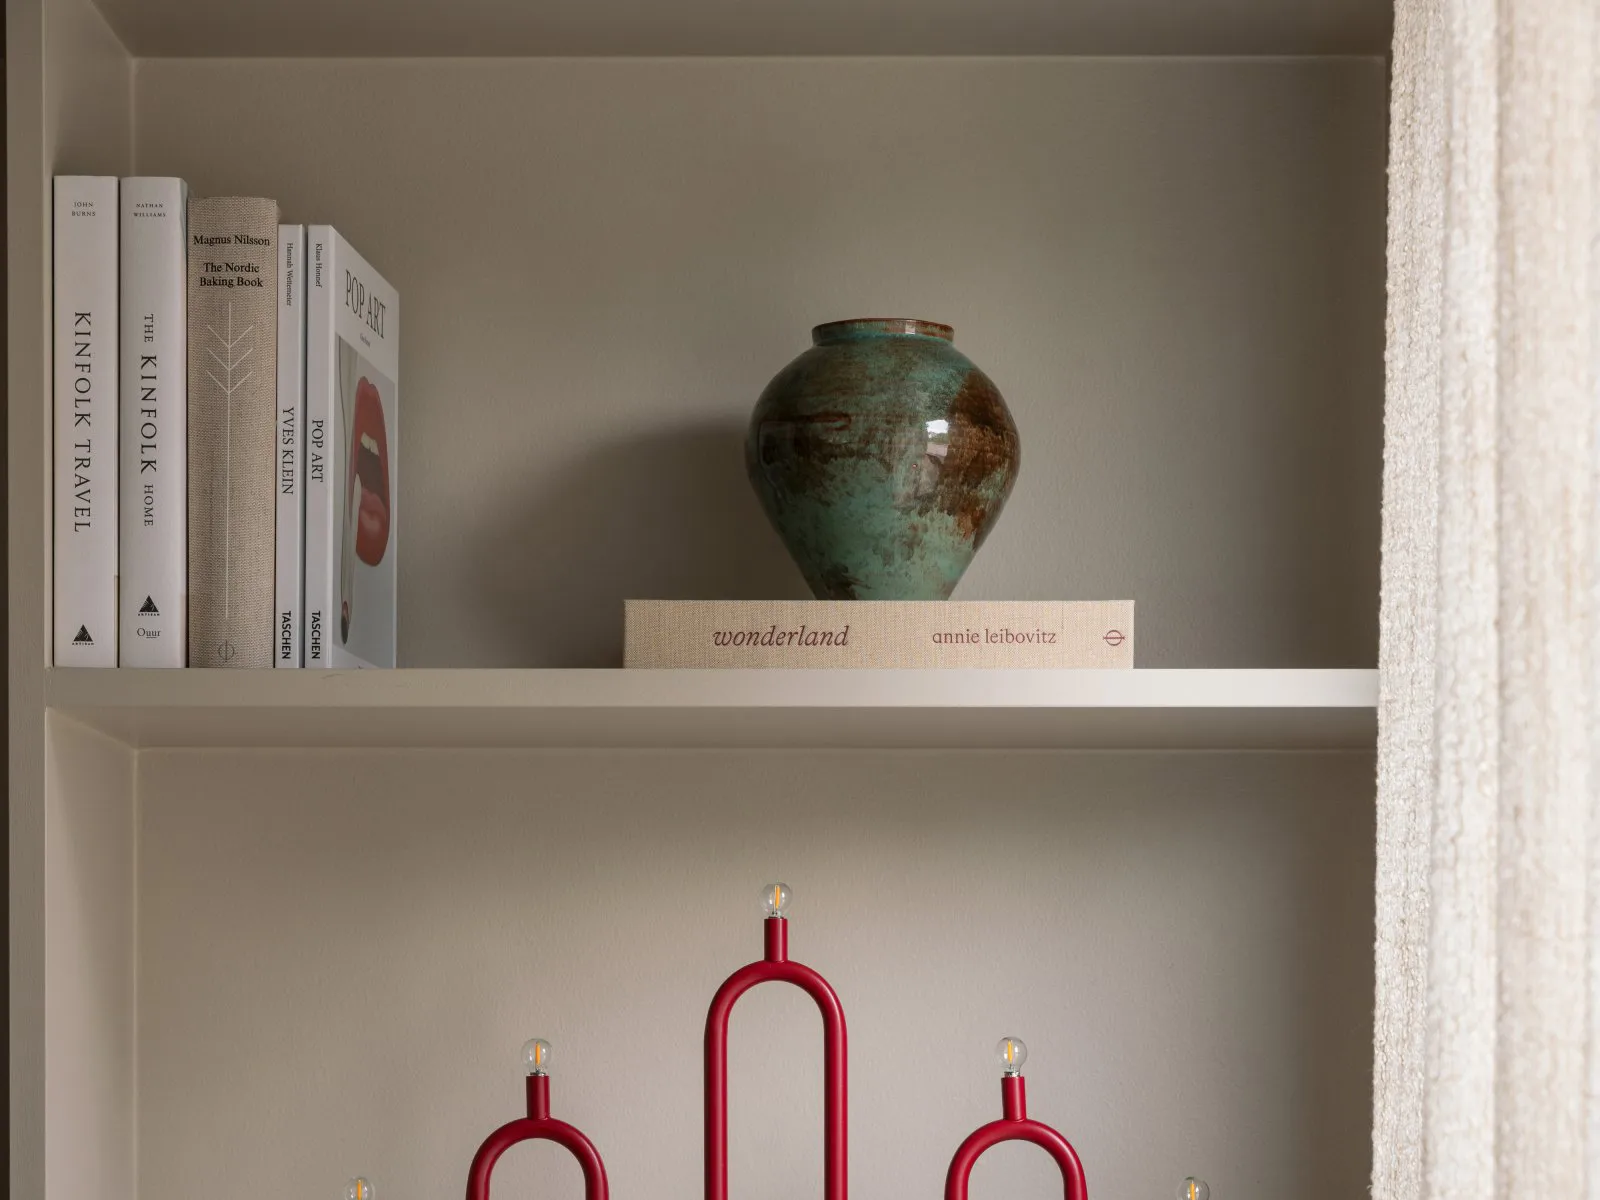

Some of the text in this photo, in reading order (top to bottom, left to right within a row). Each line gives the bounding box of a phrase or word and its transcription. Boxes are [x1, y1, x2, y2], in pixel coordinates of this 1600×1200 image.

[193, 235, 270, 247] Magnus Nilsson
[315, 243, 323, 262] Klaus
[199, 276, 264, 288] Baking Book
[203, 263, 260, 273] The Nordic
[345, 268, 365, 319] POP
[366, 291, 386, 339] ART
[74, 311, 91, 533] KINFOLK TRAVEL
[140, 313, 157, 527] THE KINFOLK HOME
[281, 406, 294, 496] YVES KLEIN
[311, 419, 324, 483] POP ART
[281, 610, 292, 660] TASCHEN
[311, 610, 321, 660] TASCHEN
[712, 625, 850, 647] wonderland
[932, 628, 1057, 644] annie leibovitz
